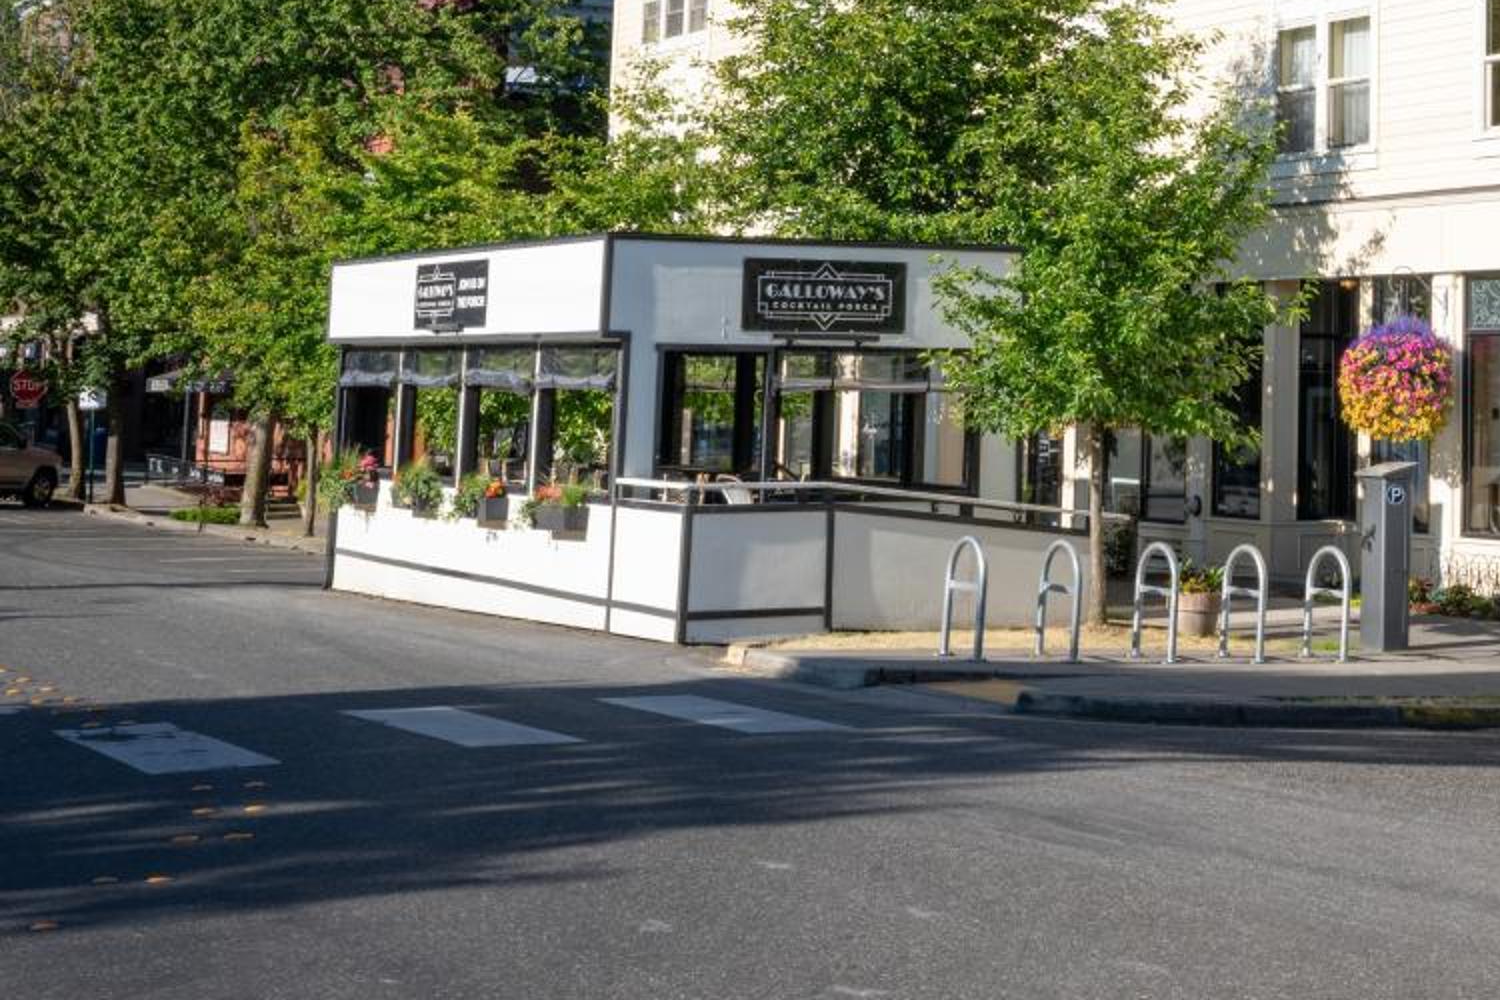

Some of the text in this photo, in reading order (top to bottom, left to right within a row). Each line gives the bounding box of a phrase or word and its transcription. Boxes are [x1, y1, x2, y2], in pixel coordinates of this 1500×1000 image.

[766, 282, 886, 302] GALLOWAY'S
[771, 301, 878, 311] COCKTAIL PORCH
